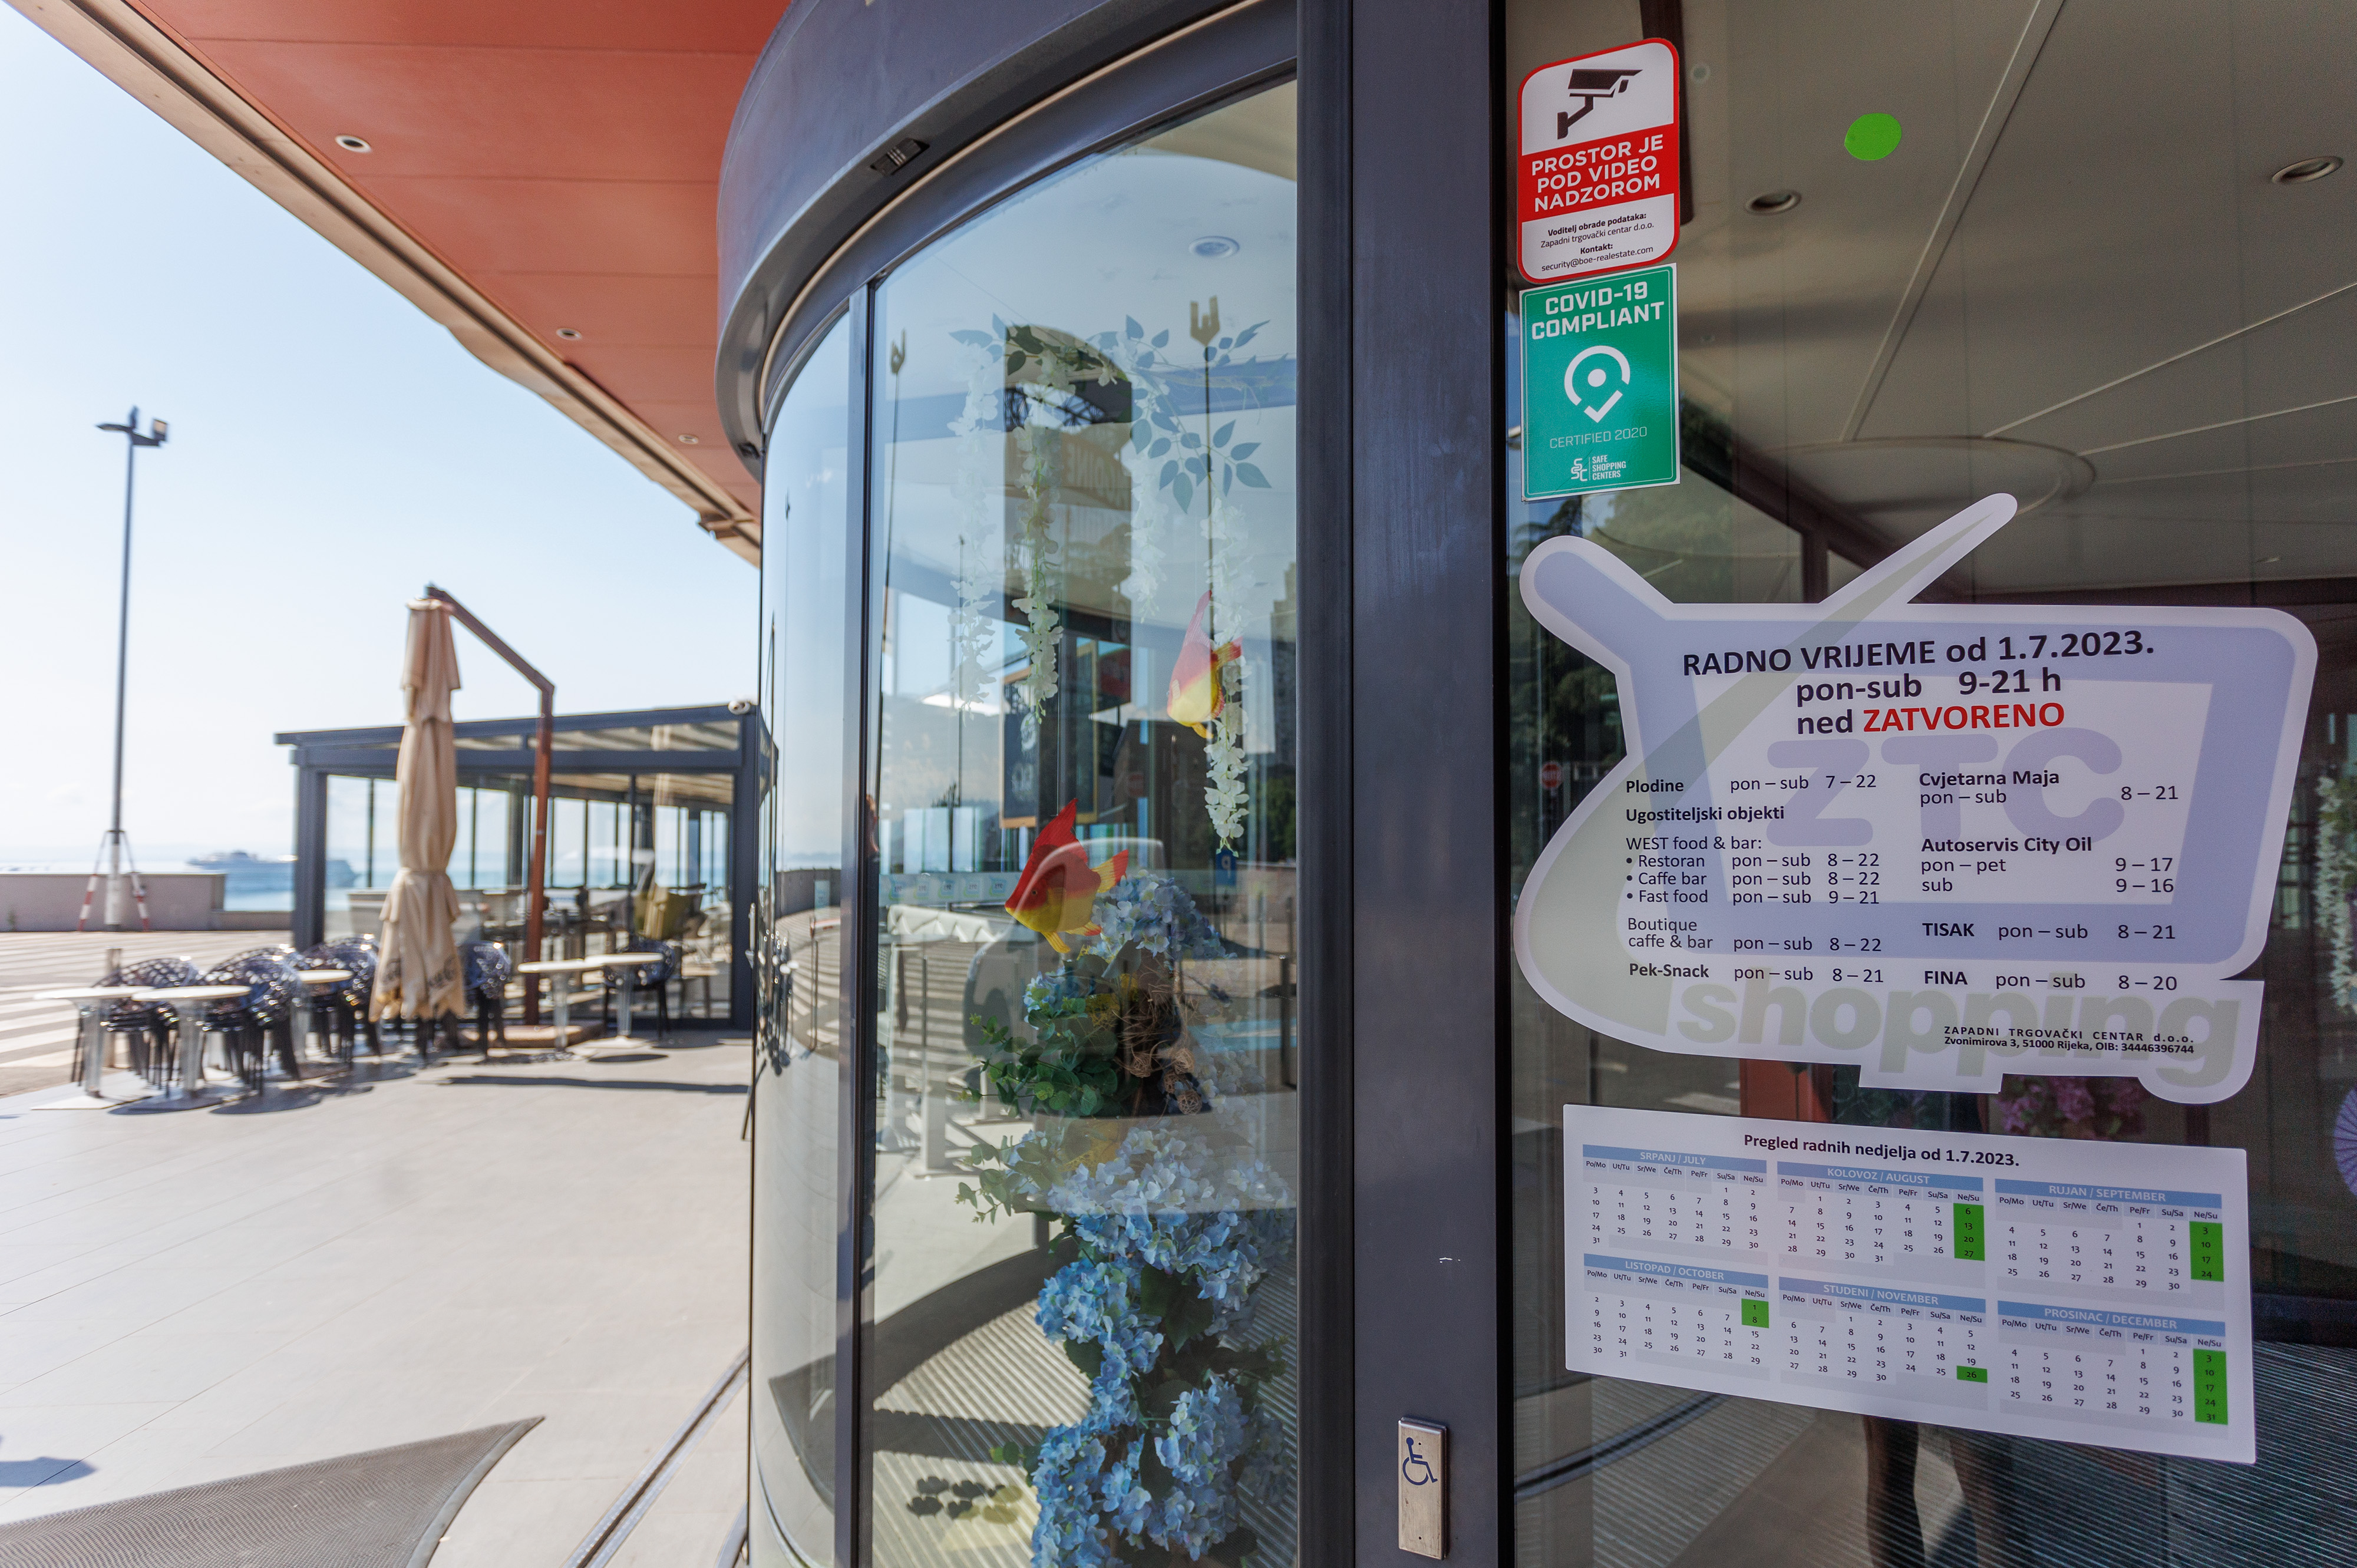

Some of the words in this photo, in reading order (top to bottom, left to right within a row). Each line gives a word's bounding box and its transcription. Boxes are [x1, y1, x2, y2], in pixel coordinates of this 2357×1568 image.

[1532, 141, 1631, 176] PROSTOR
[1639, 134, 1663, 153] JE
[1537, 171, 1581, 193] POD
[1589, 156, 1656, 182] VIDEO
[1535, 174, 1660, 212] NADZOROM
[1548, 225, 1577, 236] Voditelj
[1579, 219, 1606, 231] obrade
[1607, 213, 1646, 227] podataka:
[1541, 235, 1570, 248] Zapadni
[1572, 229, 1606, 243] trgovački
[1607, 225, 1631, 235] centar
[1633, 222, 1654, 232] d.o.o.
[1580, 243, 1613, 254] Kontakt:
[1541, 246, 1653, 271] security@boe-realestate.com
[1546, 282, 1648, 315] COVID-19
[1532, 302, 1664, 339] COMPLIANT
[1550, 431, 1611, 448] CERTIFIED
[1615, 427, 1647, 440] 2020
[1592, 455, 1607, 463] SAFE
[1592, 461, 1626, 471] SHOPPING
[1592, 470, 1620, 480] CENTERS
[1683, 648, 1791, 676] RADNO
[1800, 640, 1936, 671] VRIJEME
[1946, 636, 1986, 662] od
[1998, 630, 2154, 661] 1.7.2023.
[1797, 674, 1922, 707] pon-sub
[1959, 668, 2030, 695] 9-21
[2042, 667, 2061, 692] h
[1797, 709, 1853, 735] ned
[1863, 702, 2065, 732] ZATVORENO
[1626, 780, 1684, 793] Plodine
[1730, 778, 1760, 793] pon
[1780, 776, 1808, 788] sub
[1826, 775, 1836, 788] 7
[1856, 775, 1876, 787] 22
[1767, 728, 2125, 847] ZTC
[1919, 773, 2006, 789] Cvjetarna
[2013, 770, 2059, 787] Maja
[1920, 791, 1953, 807] pon
[1975, 789, 2006, 803] sub
[2121, 787, 2132, 800] 8
[2155, 786, 2178, 800] 21
[1626, 807, 1722, 824] Ugostiteljski
[1727, 806, 1784, 822] objekti
[1626, 837, 1669, 850] WEST
[1673, 836, 1708, 850] food
[1714, 837, 1725, 849] &
[1731, 836, 1761, 849] bar:
[1922, 839, 2018, 852] Autoservis
[2024, 837, 2060, 854] City
[2066, 837, 2092, 851] Oil
[1639, 855, 1705, 867] Restoran
[1732, 855, 1762, 870] pon
[1782, 853, 1810, 866] sub
[1828, 853, 1837, 866] 8
[1858, 853, 1879, 866] 22
[1922, 860, 1954, 874] pon
[1977, 859, 2006, 874] pet
[2115, 858, 2127, 872] 9
[2151, 858, 2173, 872] 17
[1639, 872, 1676, 885] Caffe
[1682, 872, 1706, 884] bar
[1732, 874, 1762, 888] pon
[1782, 872, 1811, 885] sub
[1828, 872, 1838, 884] 8
[1858, 872, 1880, 885] 22
[1922, 877, 1953, 892] sub
[2116, 879, 2127, 892] 9
[2151, 879, 2174, 893] 16
[1639, 890, 1668, 902] Fast
[1672, 890, 1708, 902] food
[1732, 892, 1762, 906] pon
[1782, 890, 1811, 903] sub
[1828, 890, 1838, 904] 9
[1859, 891, 1879, 905] 21
[1628, 918, 1697, 933] Boutique
[1922, 923, 1975, 937] TISAK
[1999, 926, 2032, 940] pon
[2055, 924, 2088, 939] sub
[2118, 925, 2129, 938] 8
[2153, 925, 2176, 939] 21
[1629, 935, 1664, 948] caffe
[1670, 936, 1682, 948] &
[1687, 935, 1713, 948] bar
[1734, 938, 1764, 952] pon
[1784, 937, 1813, 950] sub
[1830, 938, 1840, 950] 8
[1860, 938, 1881, 952] 22
[1629, 963, 1709, 978] Pek-Snack
[1734, 968, 1764, 981] pon
[1784, 967, 1813, 981] sub
[1832, 969, 1842, 982] 8
[1863, 969, 1883, 982] 21
[1924, 971, 1968, 985] FINA
[1996, 974, 2030, 989] pon
[2053, 973, 2085, 988] sub
[2118, 975, 2130, 989] 8
[2153, 976, 2177, 991] 20
[1677, 968, 2239, 1088] shopping
[1945, 1026, 1999, 1036] ZAPADNI
[2009, 1029, 2082, 1039] TRGOVAČKI
[2093, 1031, 2143, 1041] CENTAR
[2154, 1033, 2193, 1043] d.o.o.
[1945, 1036, 2007, 1047] Zvonimirova
[2010, 1039, 2020, 1048] 3,
[2022, 1039, 2054, 1048] 51000
[2057, 1041, 2092, 1052] Rijeka,
[2095, 1042, 2119, 1051] OIB:
[2121, 1043, 2194, 1054] 34446396744
[1640, 1152, 1675, 1162] SRPANJ
[1683, 1157, 1706, 1165] JULY
[1744, 1134, 1798, 1150] Pregled
[1803, 1139, 1850, 1154] radnih
[1855, 1143, 1916, 1161] nedjelja
[1921, 1148, 1940, 1160] od
[1946, 1150, 2019, 1166] 1.7.2023.
[1663, 1167, 1682, 1175] Če/Th
[1828, 1168, 1877, 1180] KOLOVOZ
[1886, 1173, 1930, 1184] AUGUST
[2049, 1186, 2087, 1196] RUJAN
[2097, 1189, 2165, 1201] SEPTEMBER
[1625, 1261, 1671, 1273] LISTOPAD
[1678, 1268, 1724, 1280] OCTOBER
[1824, 1285, 1869, 1297] STUDENI
[1877, 1290, 1938, 1305] NOVEMBER
[2045, 1308, 2102, 1322] PROSINAC
[2112, 1315, 2177, 1329] DECEMBER
[2011, 1391, 2020, 1399] 25
